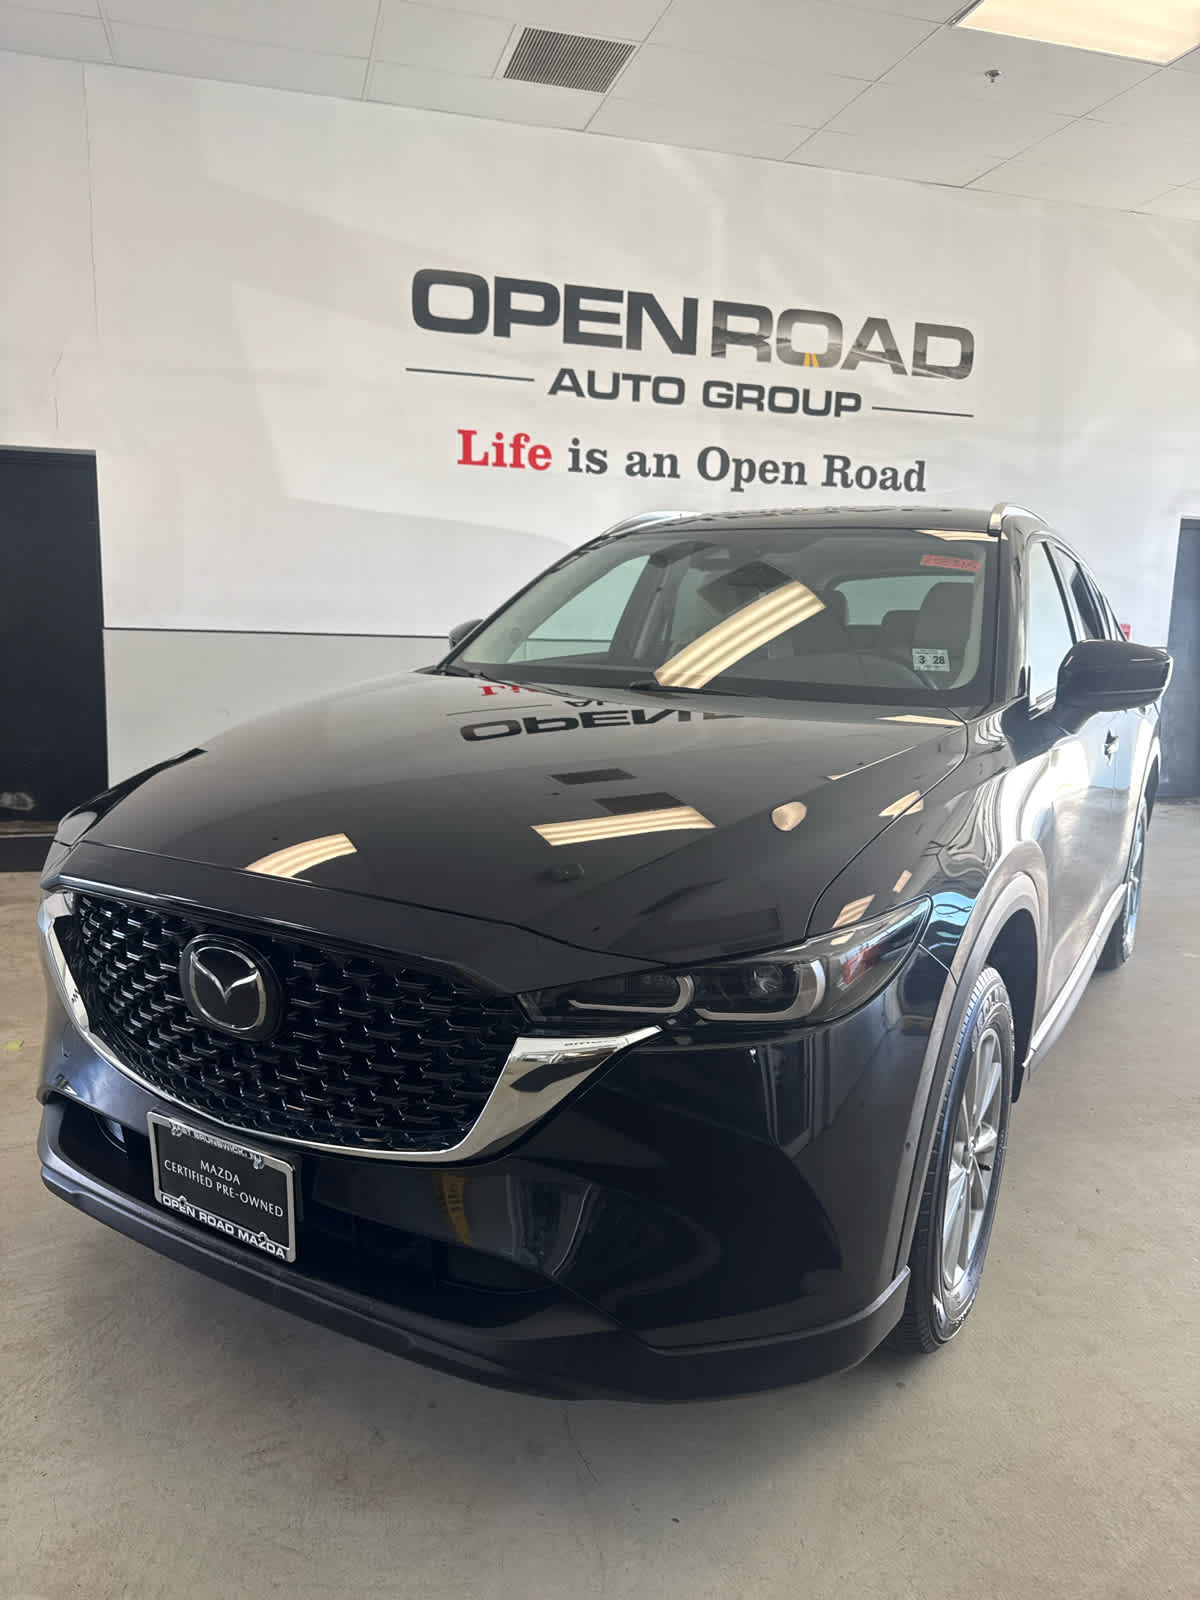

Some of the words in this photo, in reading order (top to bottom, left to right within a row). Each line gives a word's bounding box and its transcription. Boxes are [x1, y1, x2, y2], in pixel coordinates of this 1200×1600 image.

[411, 268, 699, 356] OPEN
[711, 300, 975, 380] ROAD
[548, 367, 686, 405] AUTO
[702, 380, 862, 418] GROUP
[457, 429, 552, 471] Life
[567, 437, 608, 474] is
[625, 451, 681, 479] an
[697, 446, 808, 493] Open
[821, 454, 926, 492] Road
[918, 655, 926, 665] 3
[932, 655, 946, 665] 28
[164, 1159, 213, 1188] CERTIFIED
[216, 1181, 284, 1218] PRE-OWNED
[200, 1160, 241, 1185] MAZDA
[162, 1195, 196, 1218] OPEN
[199, 1211, 234, 1235] ROAD
[237, 1229, 286, 1260] MAZDA
